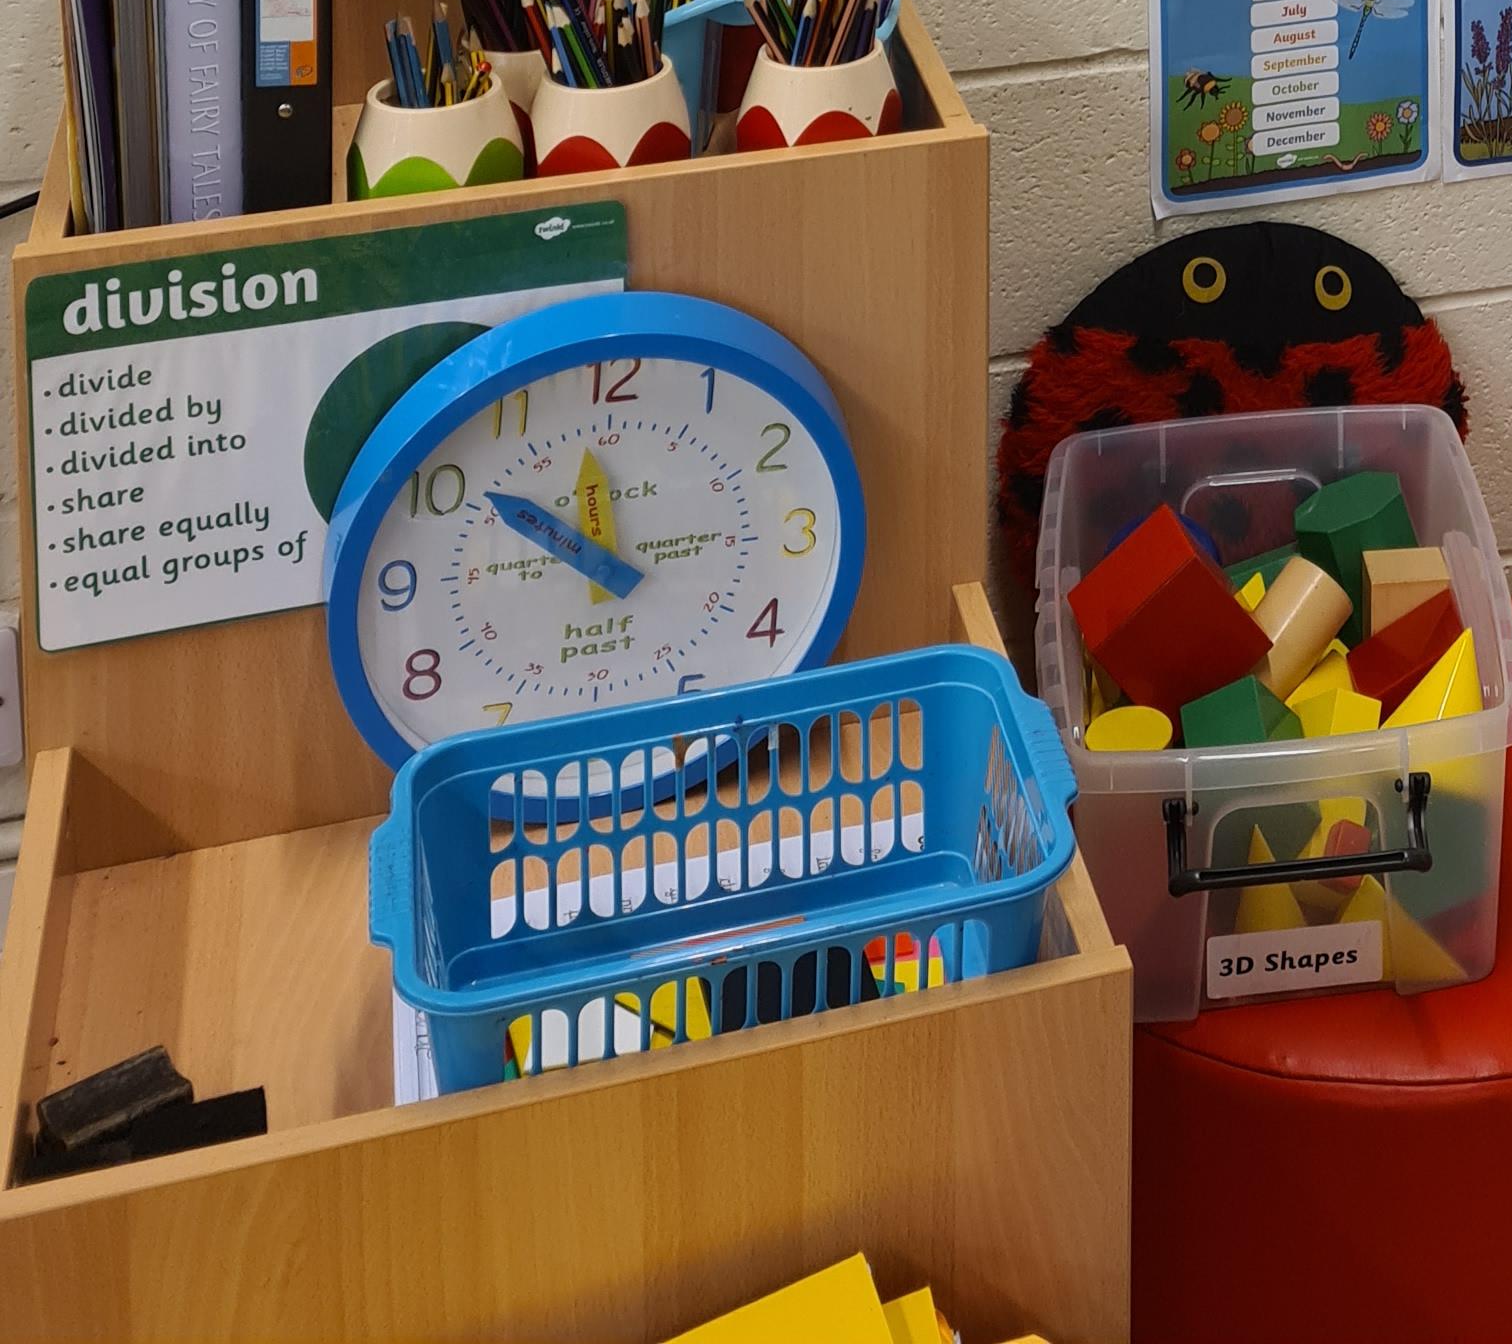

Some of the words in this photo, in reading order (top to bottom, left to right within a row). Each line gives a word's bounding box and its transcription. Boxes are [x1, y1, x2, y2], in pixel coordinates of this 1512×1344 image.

[1281, 3, 1307, 19] July
[187, 19, 220, 53] OF
[1273, 28, 1316, 46] August
[1263, 53, 1327, 73] September
[188, 63, 220, 137] FAIRY
[1271, 79, 1319, 95] October
[1266, 103, 1326, 121] November
[1266, 129, 1326, 147] December
[191, 143, 222, 222] TALES
[62, 262, 319, 337] division
[57, 364, 153, 398] divide
[59, 397, 173, 438] divided
[184, 392, 223, 426] by
[60, 438, 179, 477] divided
[187, 429, 247, 455] into
[60, 481, 145, 514] share
[62, 520, 153, 555] share
[159, 502, 271, 544] equally
[63, 556, 153, 595] equal
[162, 545, 267, 589] groups
[277, 530, 307, 566] of
[564, 614, 634, 640] half
[560, 635, 636, 663] past
[1219, 956, 1254, 977] 3D
[1265, 948, 1358, 973] Shapes
